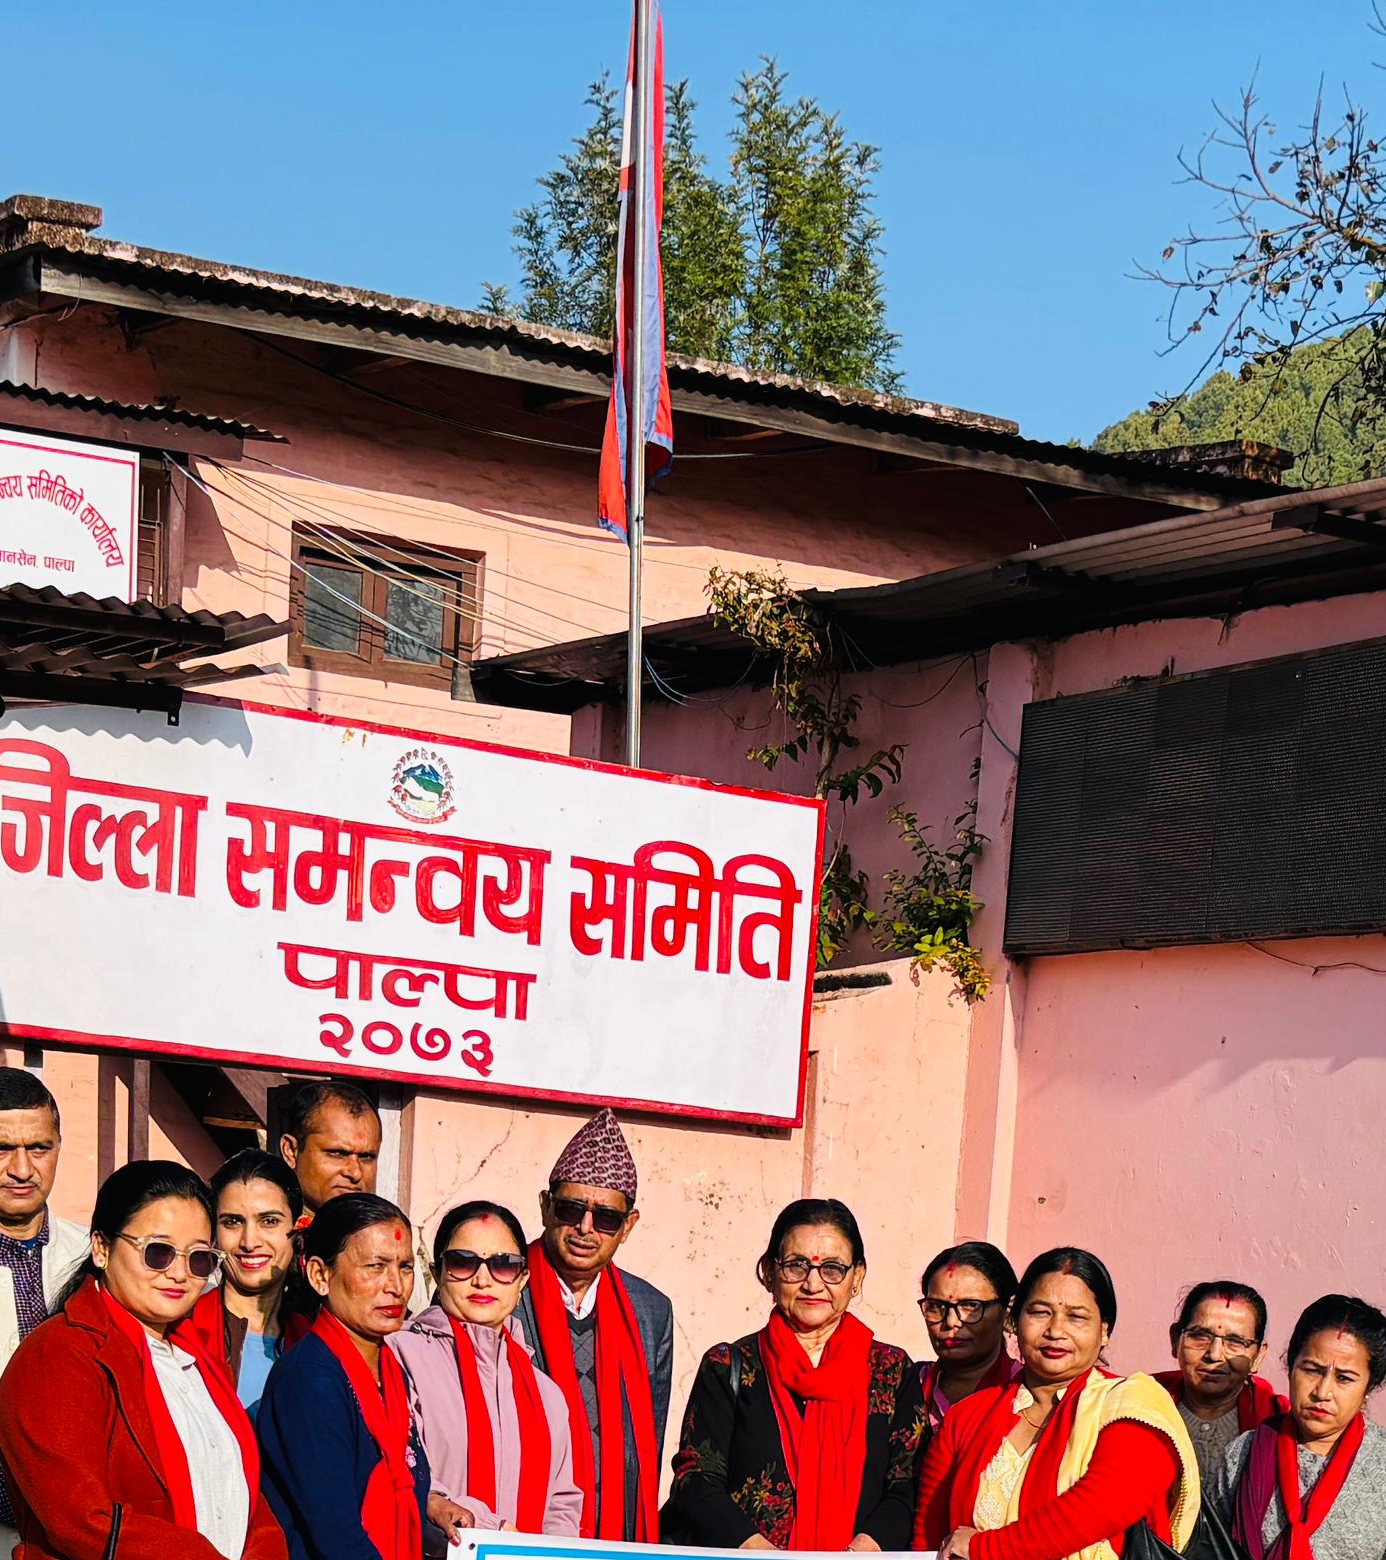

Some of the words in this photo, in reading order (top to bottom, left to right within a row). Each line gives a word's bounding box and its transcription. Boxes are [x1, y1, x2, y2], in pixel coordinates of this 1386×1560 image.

[27, 469, 84, 515] समितिको
[80, 503, 124, 567] कार्यालय
[44, 556, 75, 572] पाल्पा
[226, 801, 553, 947] समन्वय
[570, 840, 802, 982] समिति
[278, 942, 537, 1021] पाल्पा
[319, 1012, 495, 1077] २०७३
